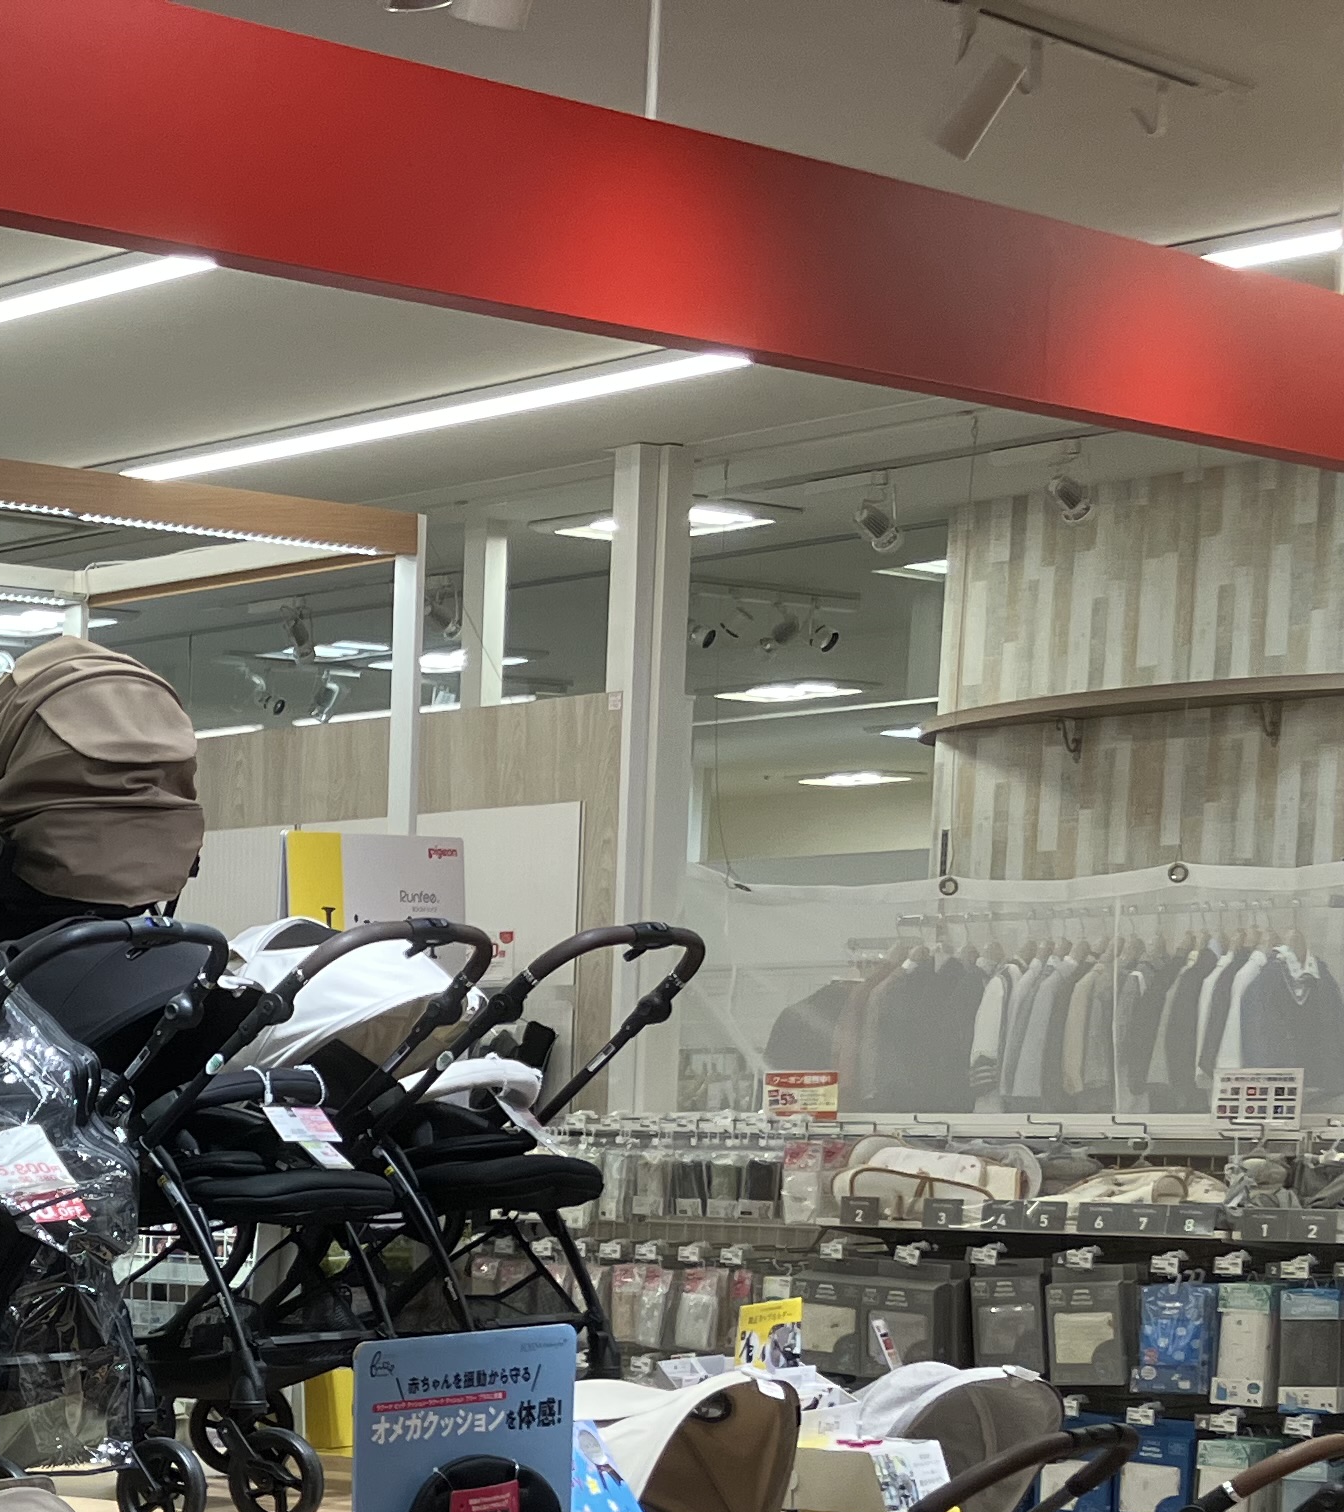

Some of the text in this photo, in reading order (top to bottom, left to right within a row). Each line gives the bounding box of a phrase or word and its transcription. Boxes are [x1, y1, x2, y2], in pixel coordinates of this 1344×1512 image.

[427, 845, 458, 859] pigeon
[59, 1205, 82, 1218] OFF
[854, 1209, 864, 1222] 2
[937, 1212, 946, 1225] 3
[997, 1214, 1006, 1226] 4
[1039, 1214, 1049, 1228] 5
[1093, 1216, 1104, 1229] 6
[1138, 1217, 1148, 1231] 7
[1183, 1218, 1195, 1232] 8
[1261, 1224, 1269, 1238] 1
[1307, 1225, 1318, 1239] 2
[407, 1366, 532, 1395] 赤ちゃんを振動から守る
[370, 1397, 563, 1446] オメガクッションを体感!
